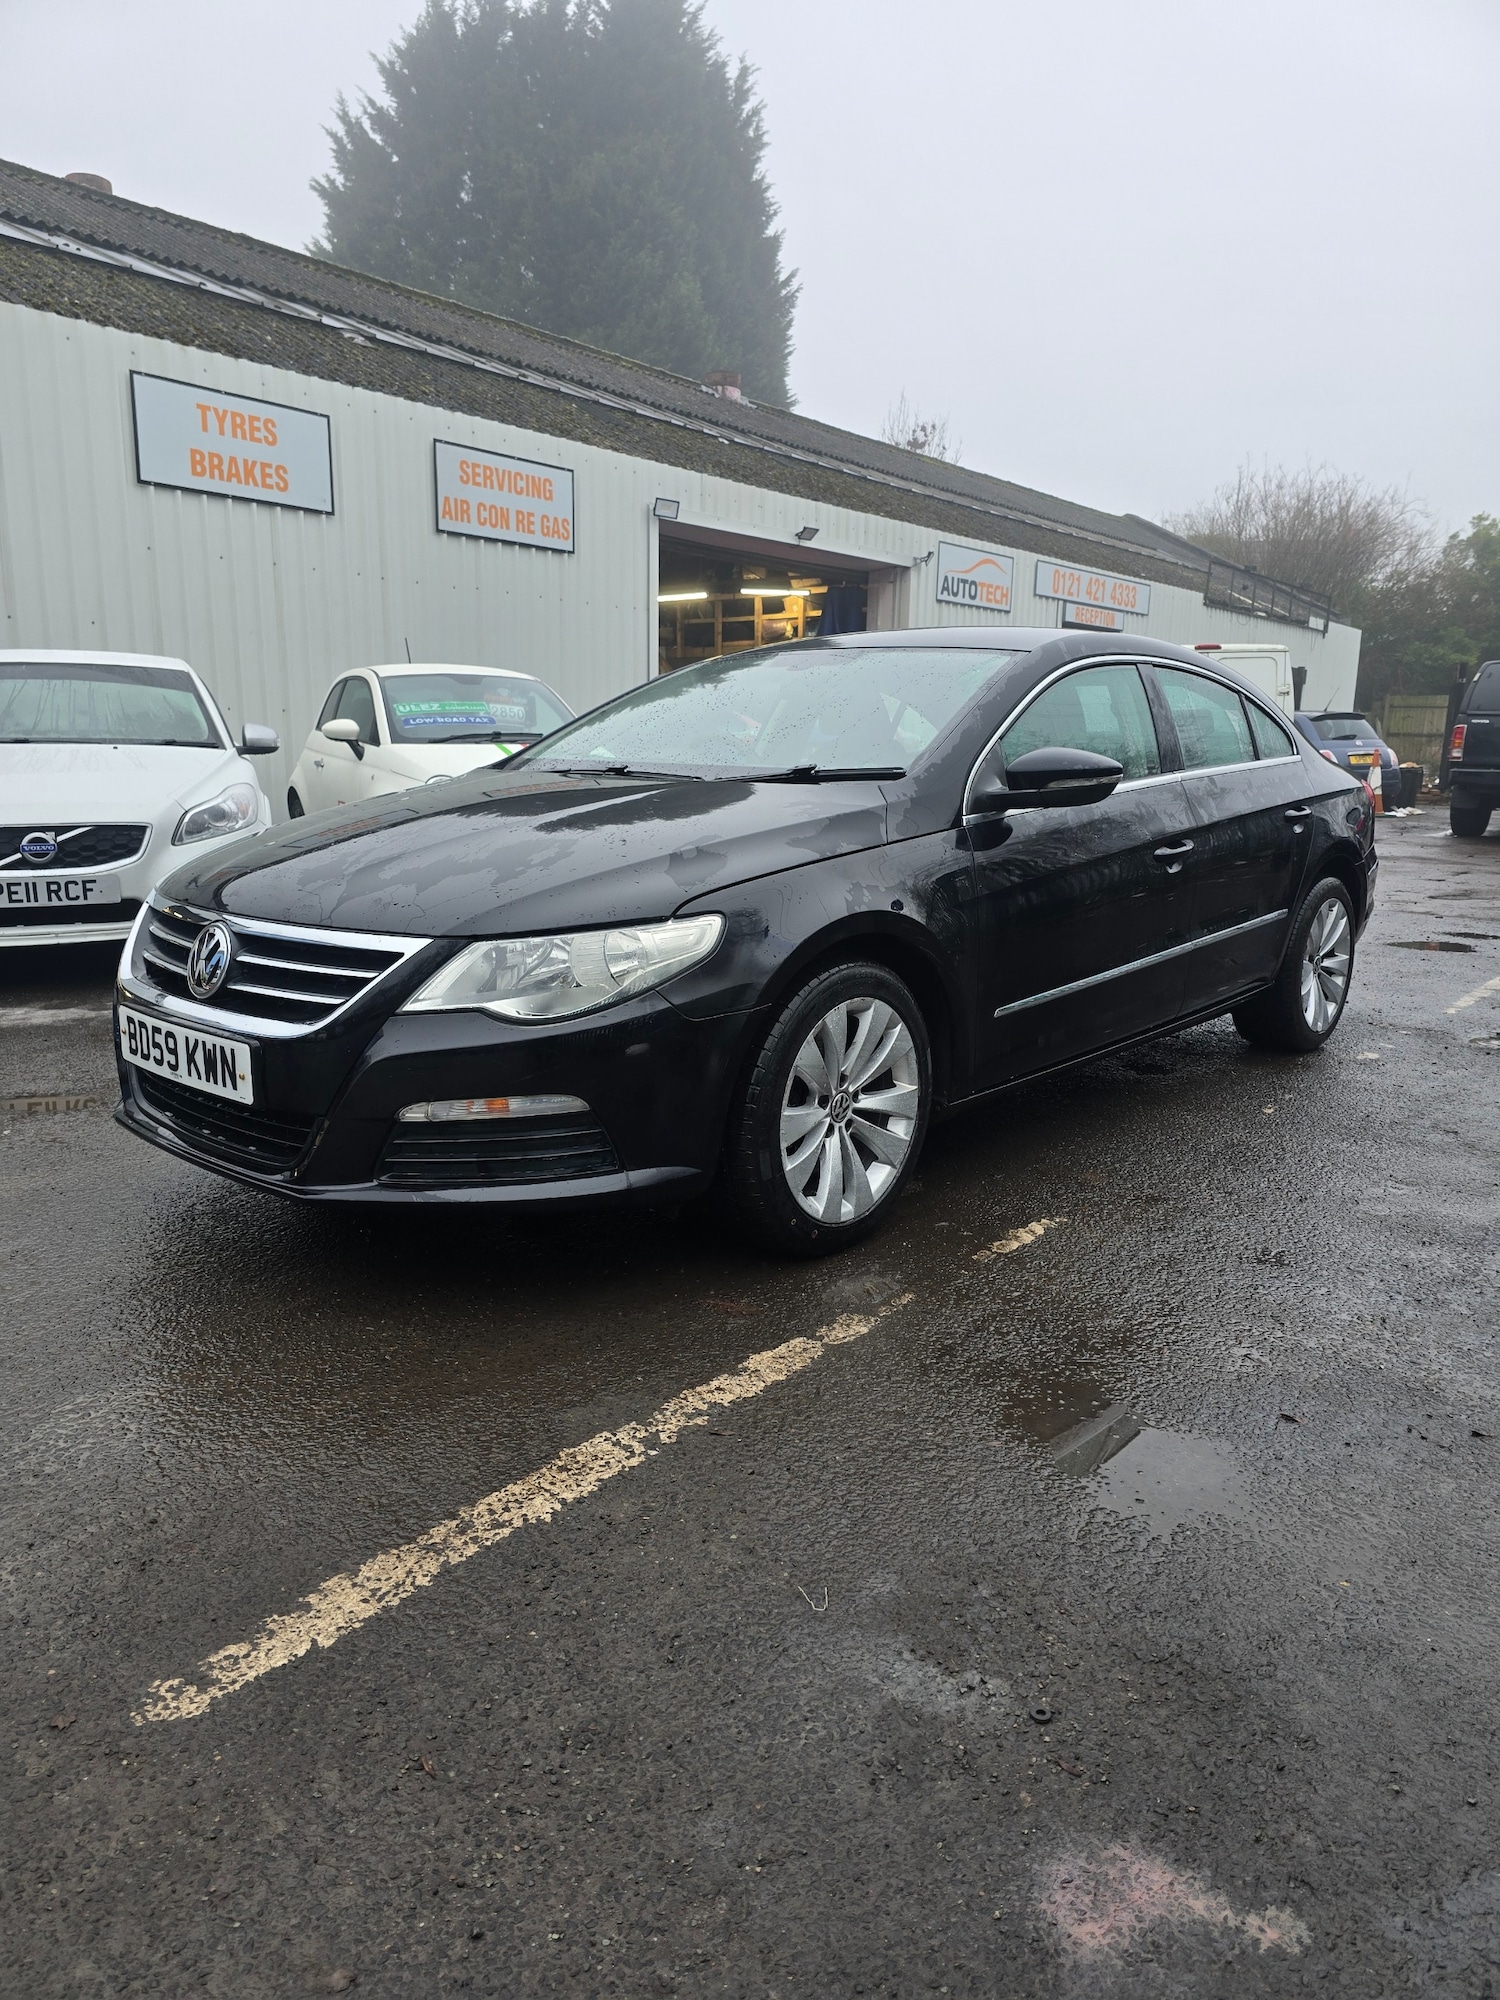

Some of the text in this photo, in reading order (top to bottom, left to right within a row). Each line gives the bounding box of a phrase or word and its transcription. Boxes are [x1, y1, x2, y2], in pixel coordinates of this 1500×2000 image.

[196, 403, 278, 447] TYRES
[190, 448, 289, 493] BRAKES
[458, 459, 554, 502] SERVICING
[441, 496, 570, 541] AIR CON RE GAS
[940, 575, 1009, 606] AUTOTECH
[1052, 568, 1137, 609] 0121 421 4333
[1075, 606, 1116, 627] RECEPTION
[409, 717, 434, 725] LOW
[438, 716, 466, 724] ROAD
[491, 705, 525, 720] 2850
[46, 879, 97, 902] RCF
[126, 1015, 238, 1092] BD59 KWN
